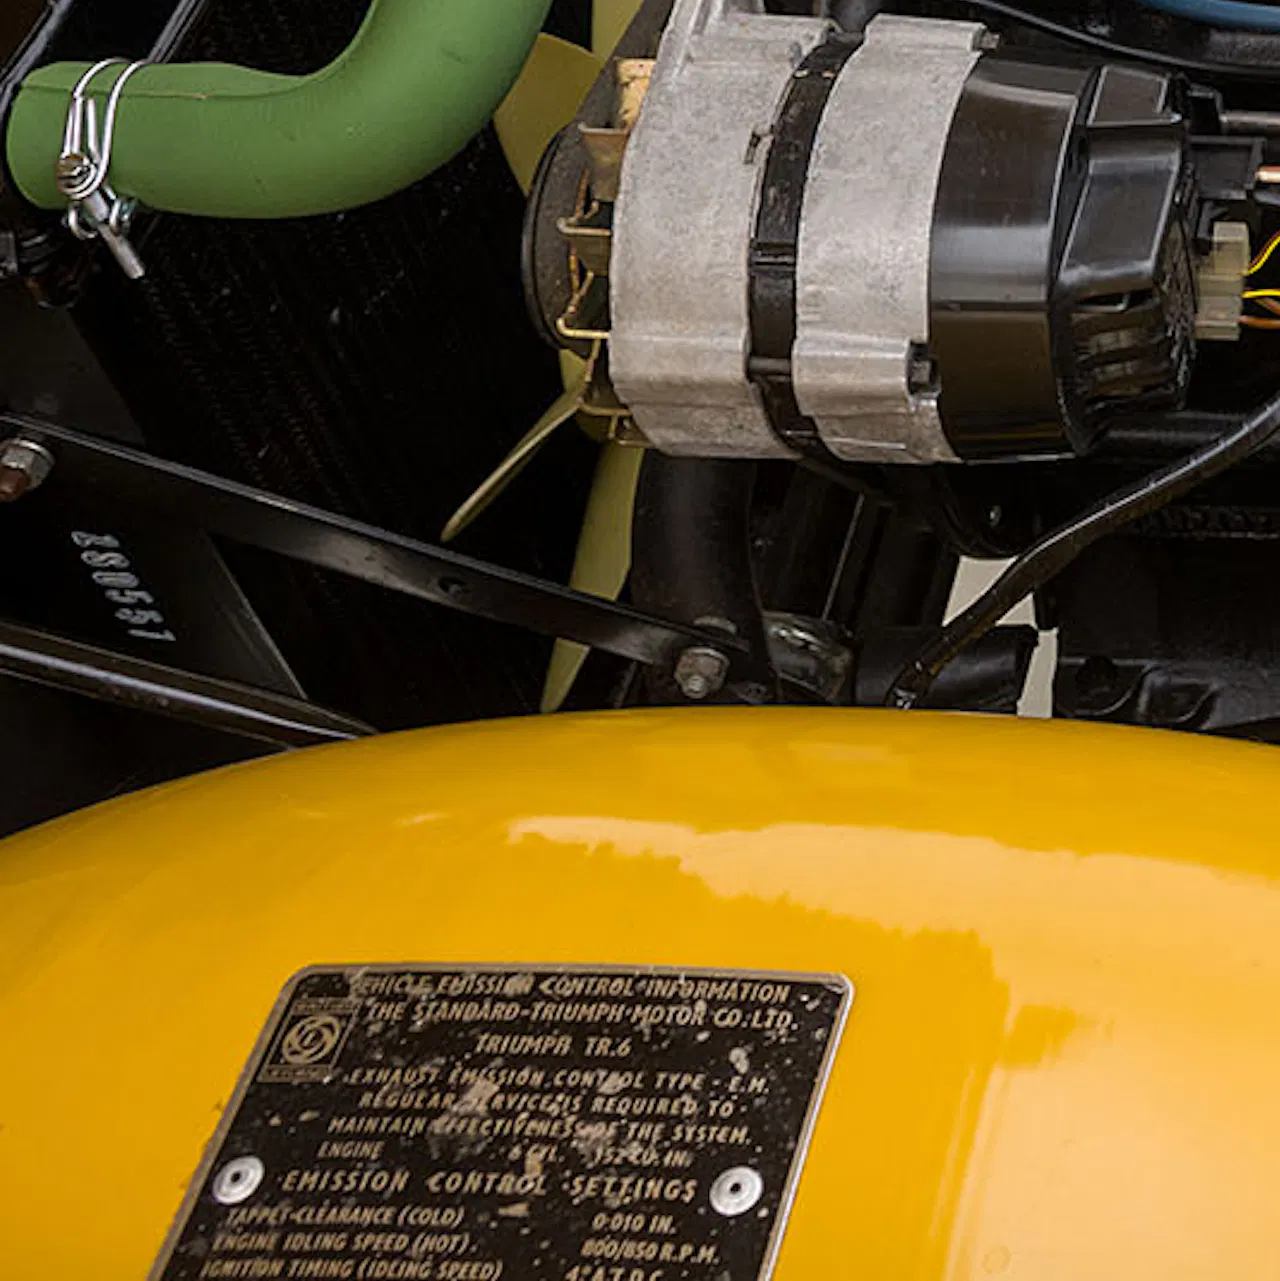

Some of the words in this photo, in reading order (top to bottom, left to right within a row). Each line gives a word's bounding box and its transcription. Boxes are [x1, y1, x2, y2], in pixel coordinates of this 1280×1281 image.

[539, 975, 634, 998] CONTROL
[645, 978, 790, 1004] INFORMATION
[367, 1001, 404, 1021] THE
[630, 1003, 707, 1026] MOTOR
[476, 1033, 573, 1056] TRIUMPH
[348, 1067, 440, 1084] EXHAUST
[654, 1071, 706, 1091] TYPE
[358, 1091, 456, 1110] REGULAR
[590, 1096, 697, 1118] REQUIRED
[708, 1100, 735, 1119] TO
[327, 1115, 427, 1135] MAINTAIN
[626, 1122, 665, 1142] THE
[317, 1140, 385, 1161] ENGINE
[281, 1169, 411, 1193] EMISSION
[426, 1172, 548, 1197] CONTROL
[568, 1175, 698, 1203] SETTINGS
[396, 1204, 464, 1229] (COLD)
[211, 1232, 281, 1252] ENGINE
[283, 1232, 349, 1252] IDLING
[351, 1232, 409, 1252] SPEED
[199, 1258, 285, 1280] IGNITION
[287, 1258, 355, 1279] TIMING
[356, 1256, 434, 1281] (IDLING
[435, 1258, 504, 1281] SPEED)
